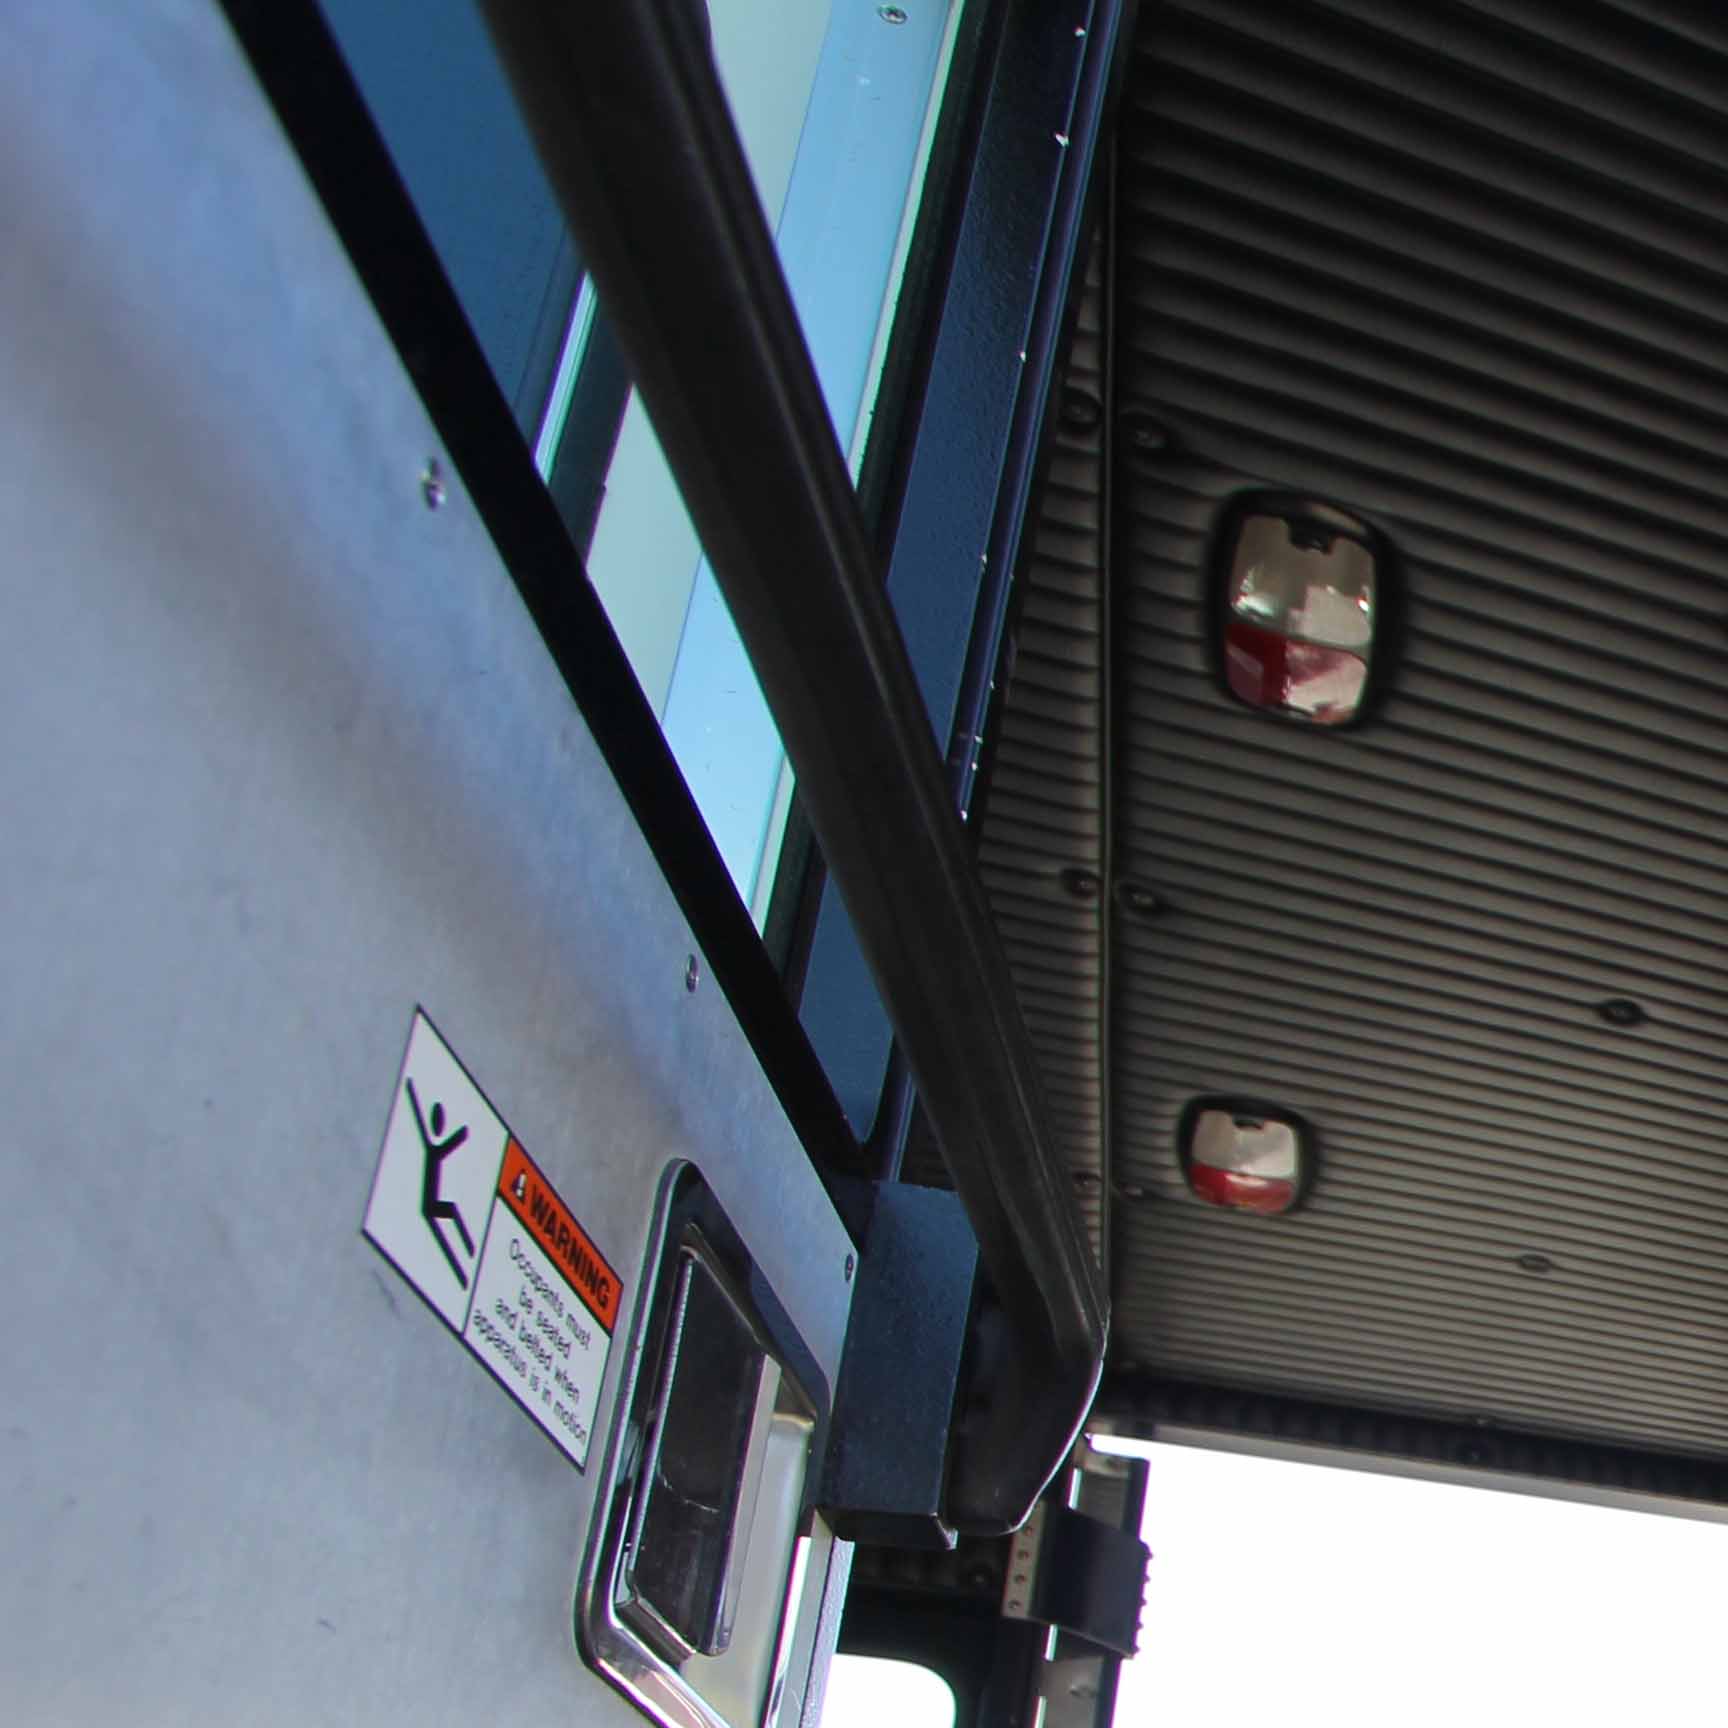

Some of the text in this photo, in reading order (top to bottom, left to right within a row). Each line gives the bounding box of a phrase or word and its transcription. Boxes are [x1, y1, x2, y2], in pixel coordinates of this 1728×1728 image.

[509, 1237, 591, 1352] Occupants must
[530, 1184, 611, 1309] WARNING
[473, 1308, 528, 1376] apparatus
[554, 1400, 588, 1445] motion
[496, 1297, 580, 1404] and belted when
[536, 1311, 571, 1358] seated
